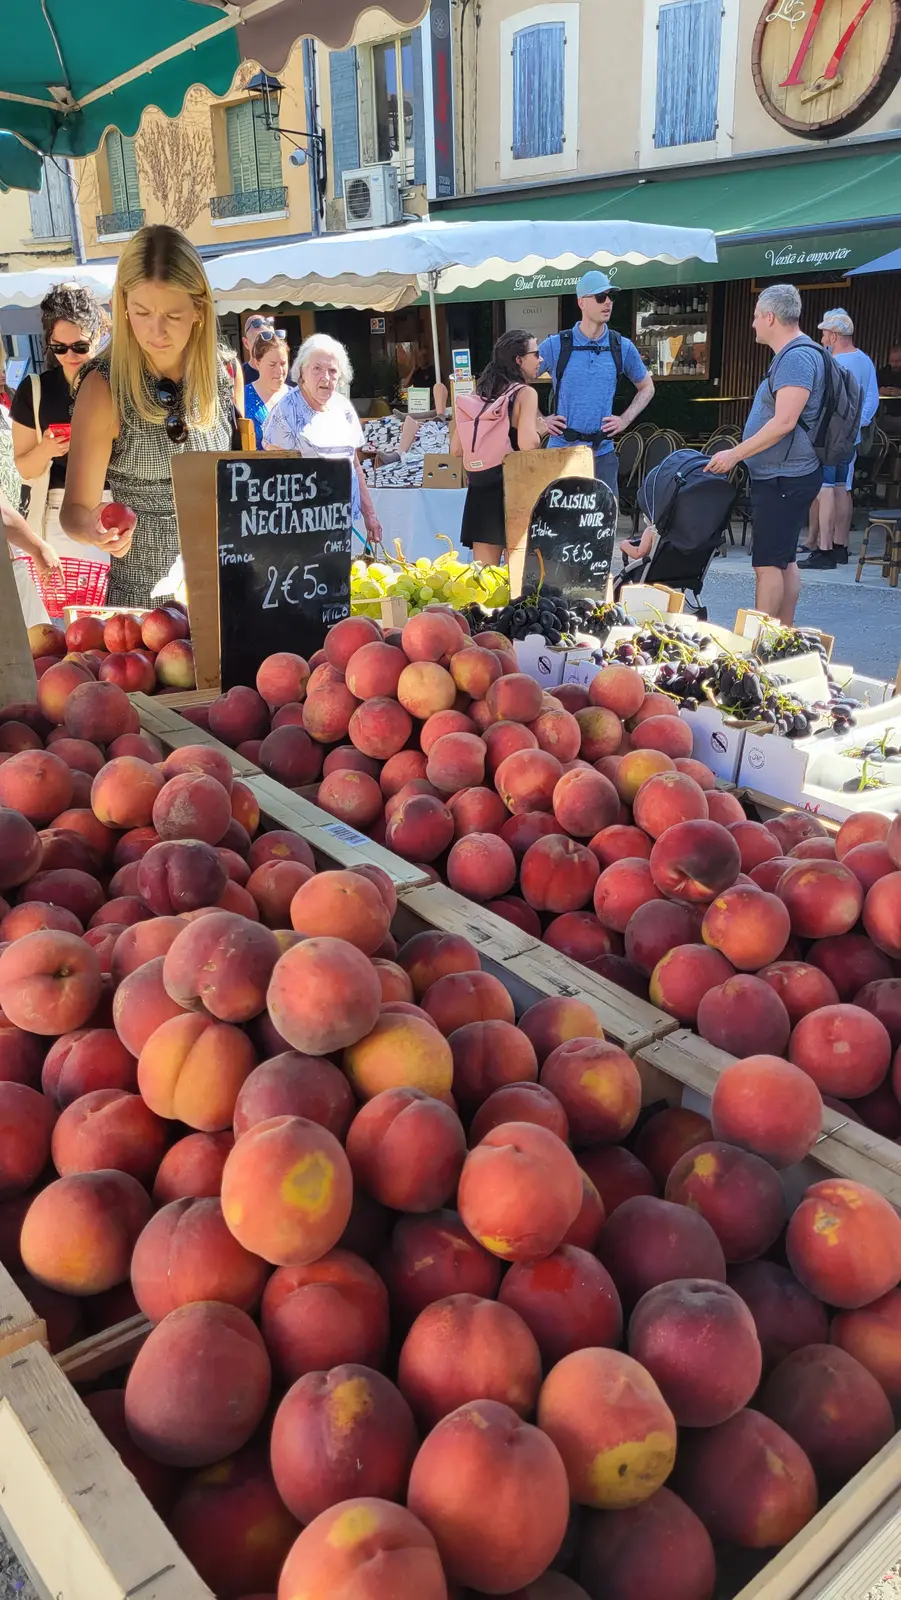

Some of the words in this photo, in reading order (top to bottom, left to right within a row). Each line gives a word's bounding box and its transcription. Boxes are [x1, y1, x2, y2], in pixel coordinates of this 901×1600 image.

[765, 244, 797, 266] Vente
[797, 251, 806, 263] à
[806, 247, 852, 267] emporter
[513, 275, 536, 291] Quel
[534, 274, 550, 289] bon
[551, 276, 562, 287] vin
[227, 462, 317, 502] PECHES
[549, 489, 597, 509] RAISINS
[241, 502, 352, 537] NECTARINES
[578, 512, 605, 527] NOIR
[218, 544, 255, 566] France
